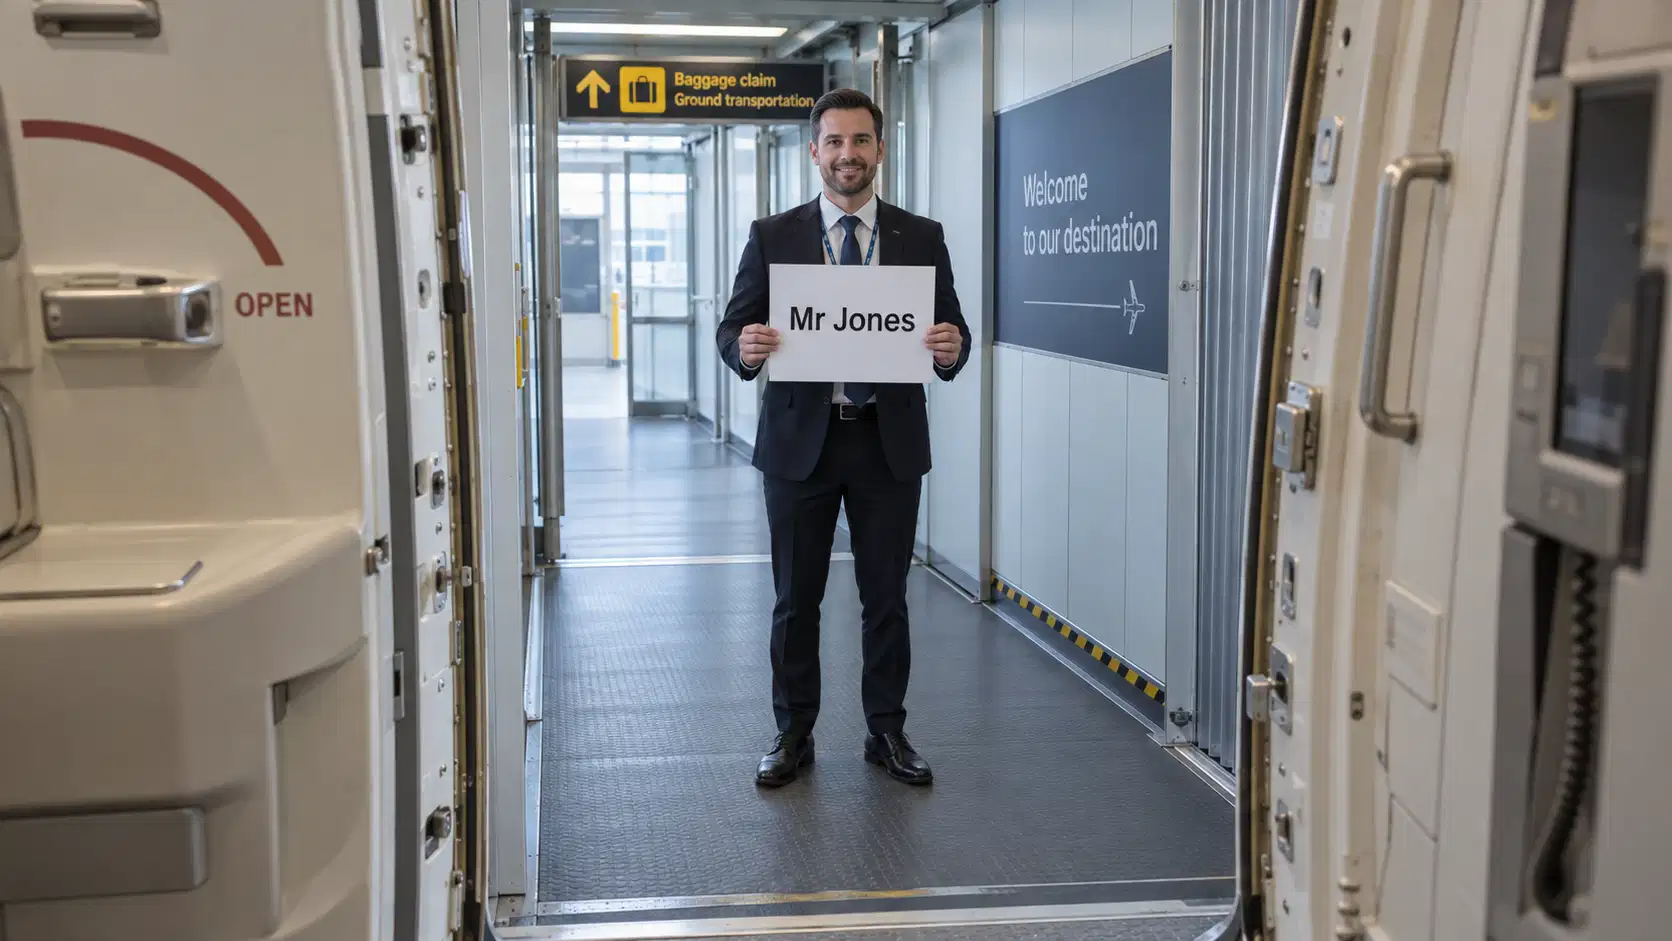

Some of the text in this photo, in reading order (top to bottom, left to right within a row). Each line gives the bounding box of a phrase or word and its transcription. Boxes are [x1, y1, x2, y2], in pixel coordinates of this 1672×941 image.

[674, 71, 777, 90] Baggage claim
[674, 92, 815, 109] Ground transportation
[1023, 170, 1088, 208] Welcome
[1023, 211, 1158, 256] to our destination
[235, 291, 313, 317] OPEN
[790, 306, 916, 332] Mr Jones
